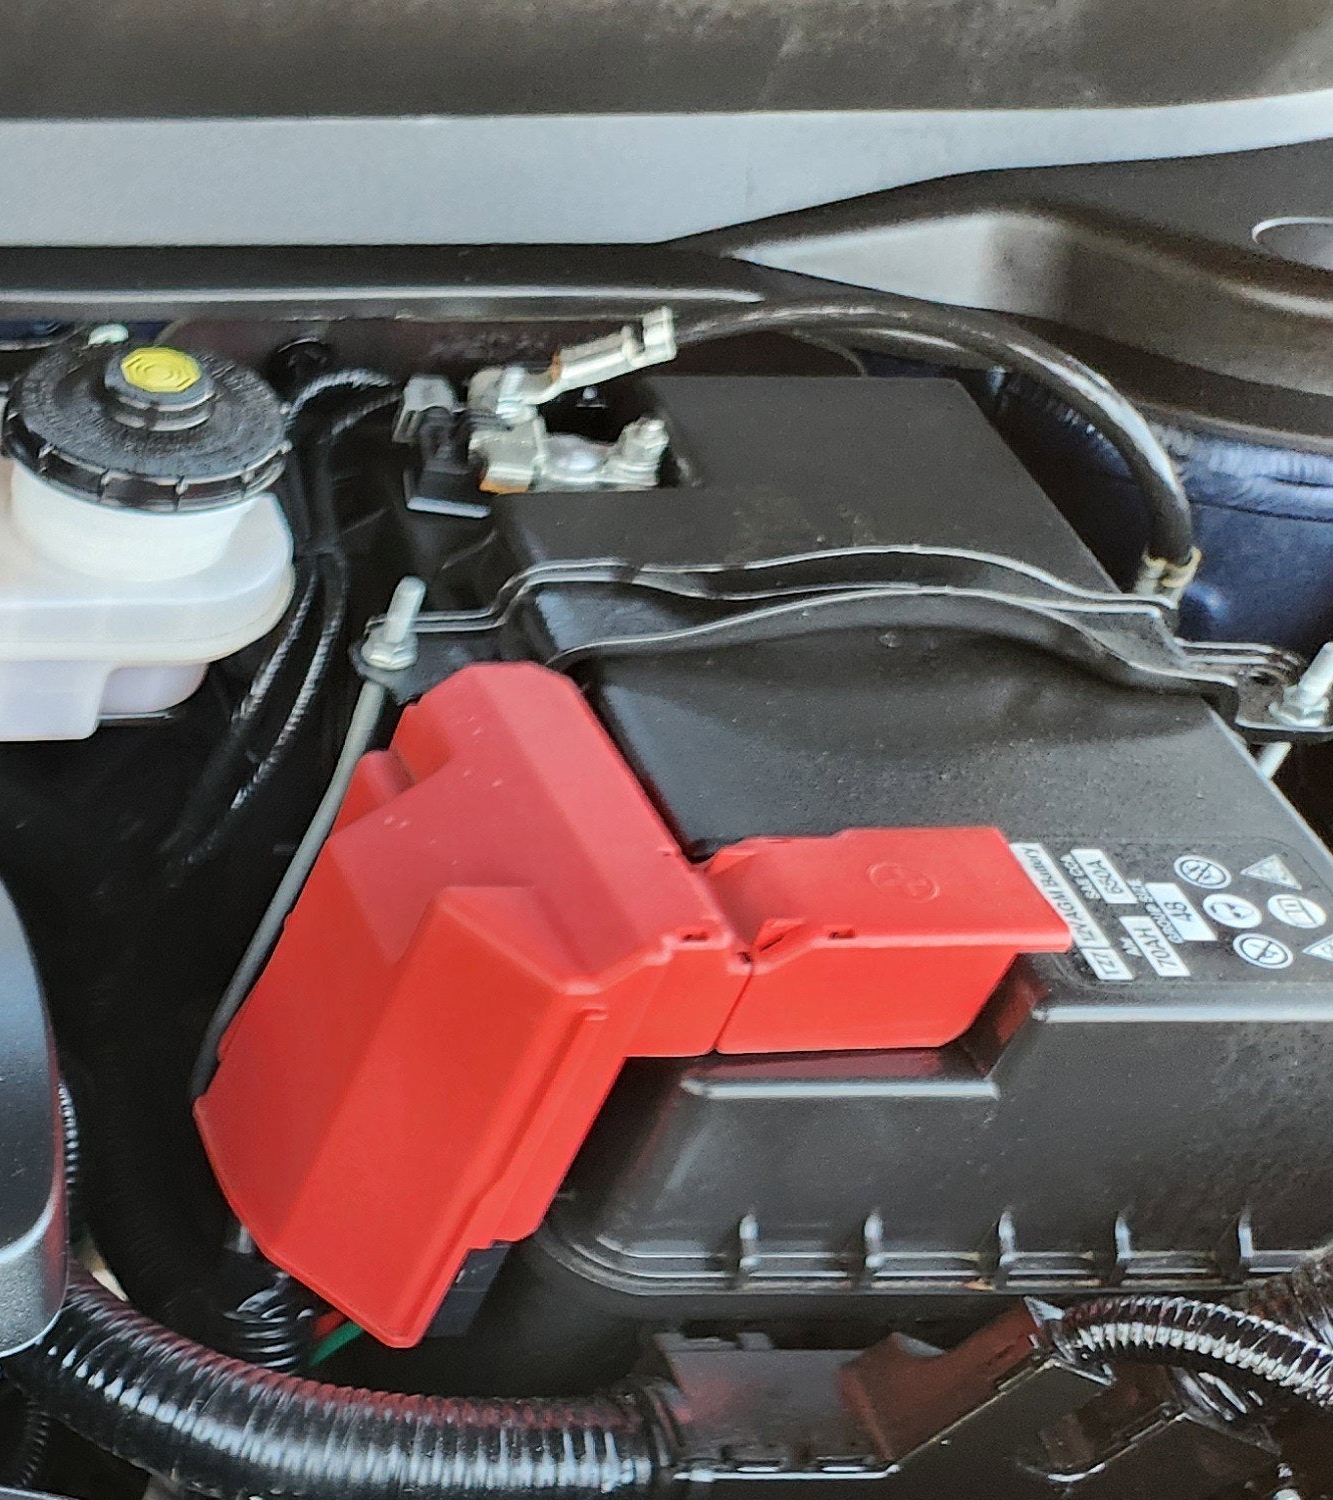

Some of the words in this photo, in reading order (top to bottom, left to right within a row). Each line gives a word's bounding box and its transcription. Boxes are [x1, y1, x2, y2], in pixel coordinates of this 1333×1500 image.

[1021, 847, 1059, 887] Battery
[1086, 860, 1124, 894] 650A
[1163, 901, 1192, 922] 48
[1134, 927, 1177, 967] 70AH
